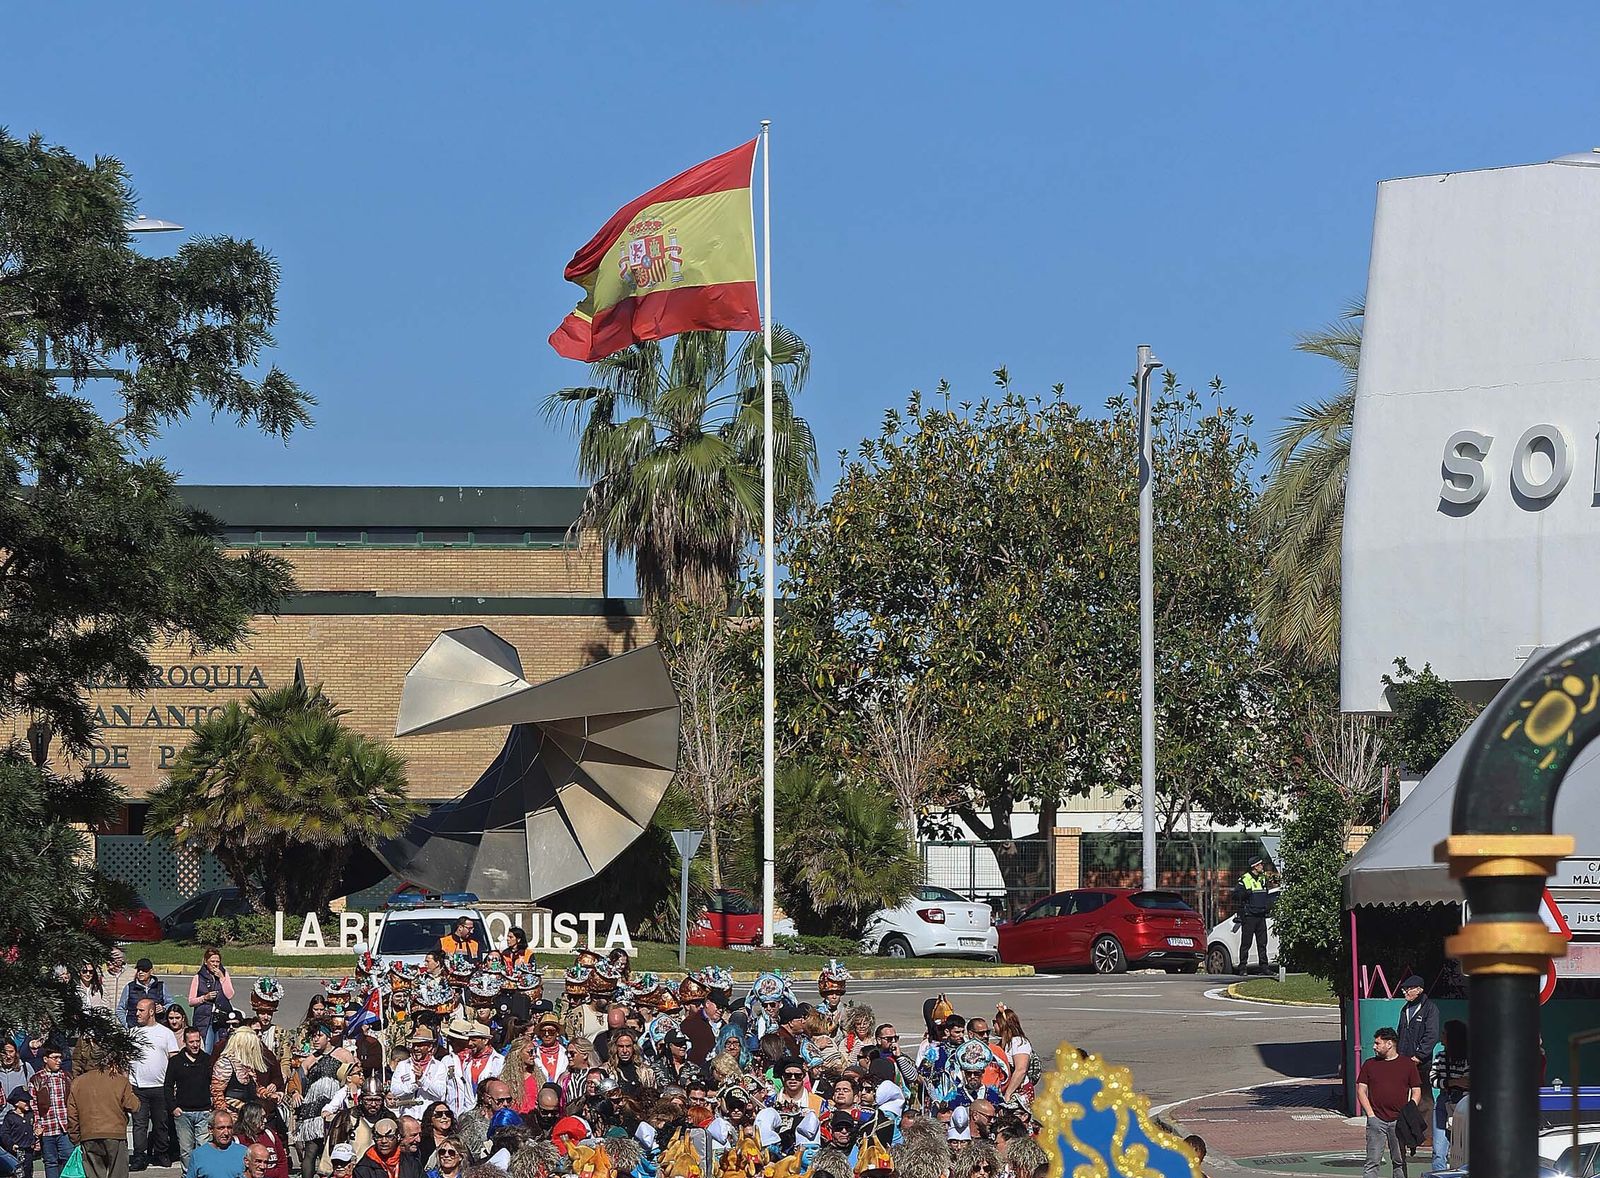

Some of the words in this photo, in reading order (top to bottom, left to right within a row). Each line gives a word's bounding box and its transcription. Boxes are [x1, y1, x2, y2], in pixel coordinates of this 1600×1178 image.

[1440, 423, 1600, 511] SO
[93, 704, 132, 728] AN
[90, 745, 130, 768] DE
[1573, 874, 1600, 885] MÁL
[275, 911, 326, 948] LA
